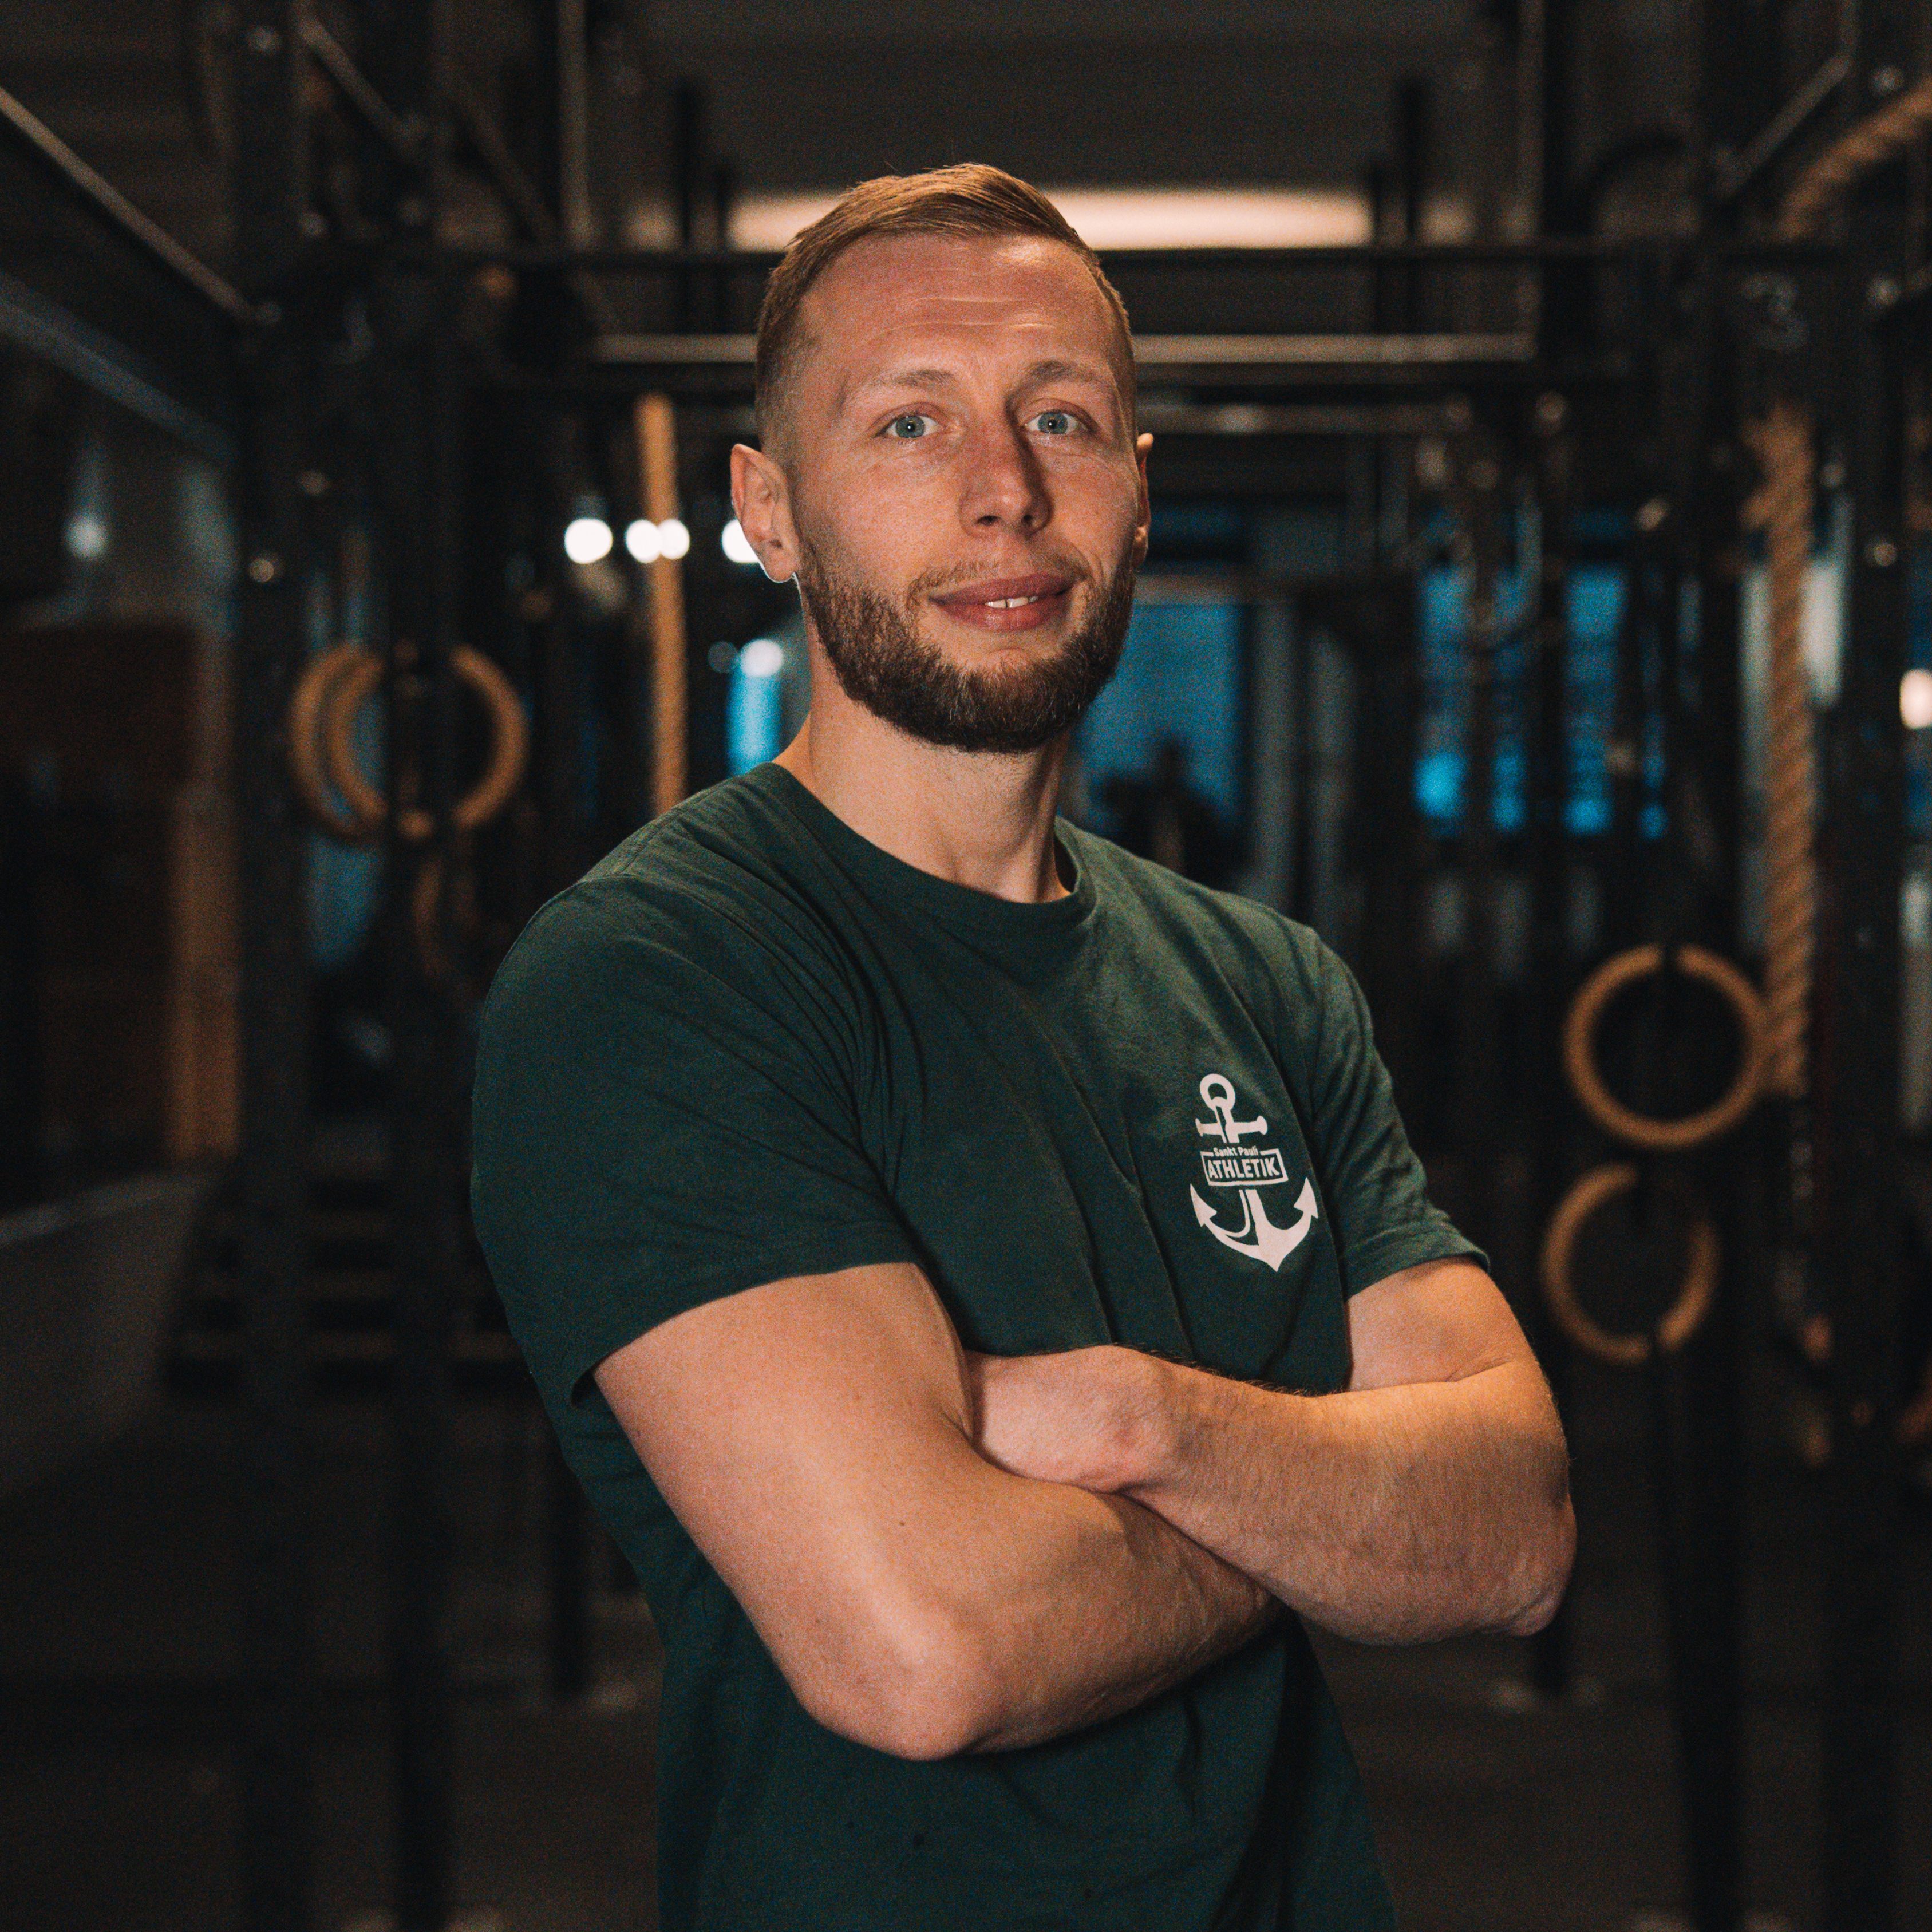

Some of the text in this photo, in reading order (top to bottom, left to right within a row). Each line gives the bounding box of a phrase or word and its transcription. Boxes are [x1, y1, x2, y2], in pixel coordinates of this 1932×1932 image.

[1213, 1145, 1259, 1157] Sankt Pauli
[1208, 1157, 1280, 1178] ATHLETIK
